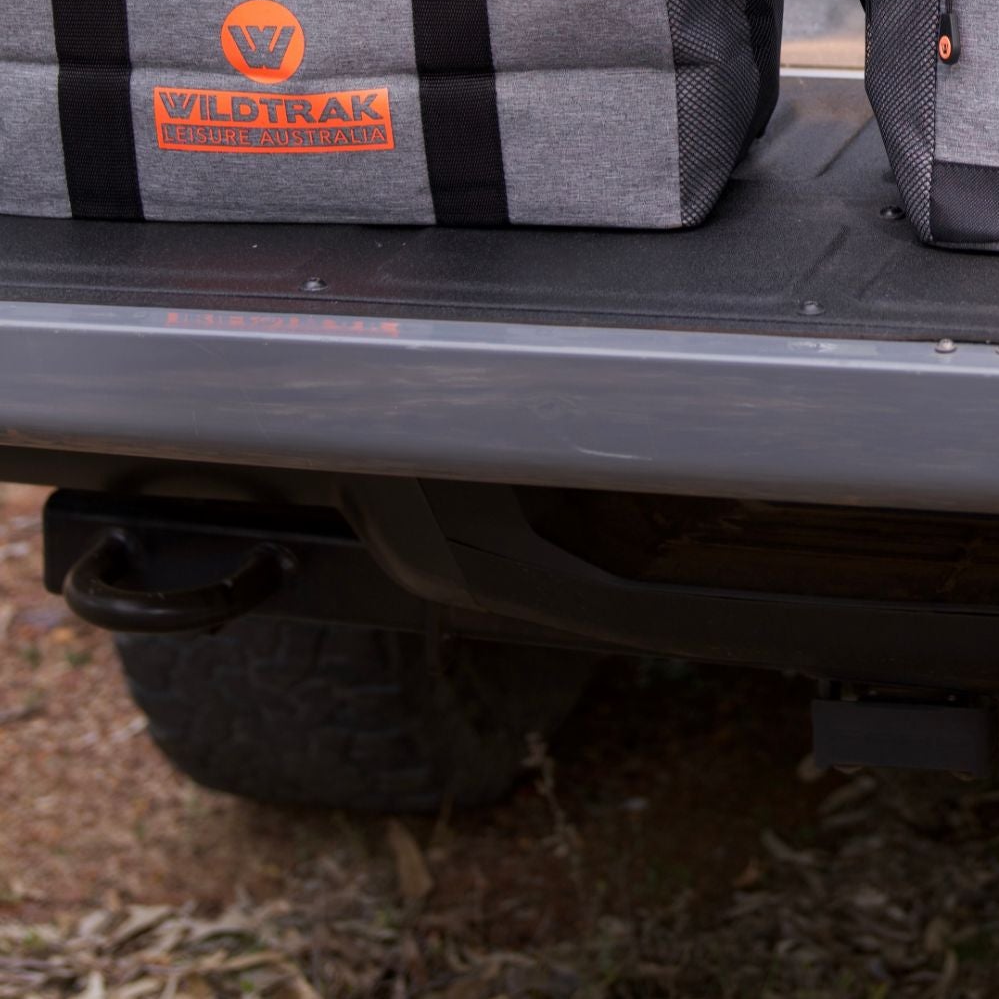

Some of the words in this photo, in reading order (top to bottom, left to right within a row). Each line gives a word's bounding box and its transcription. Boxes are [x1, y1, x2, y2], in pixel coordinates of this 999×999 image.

[159, 92, 384, 124] WILDTRAK
[162, 125, 250, 146] LEISURE
[259, 126, 387, 147] AUSTRALIA
